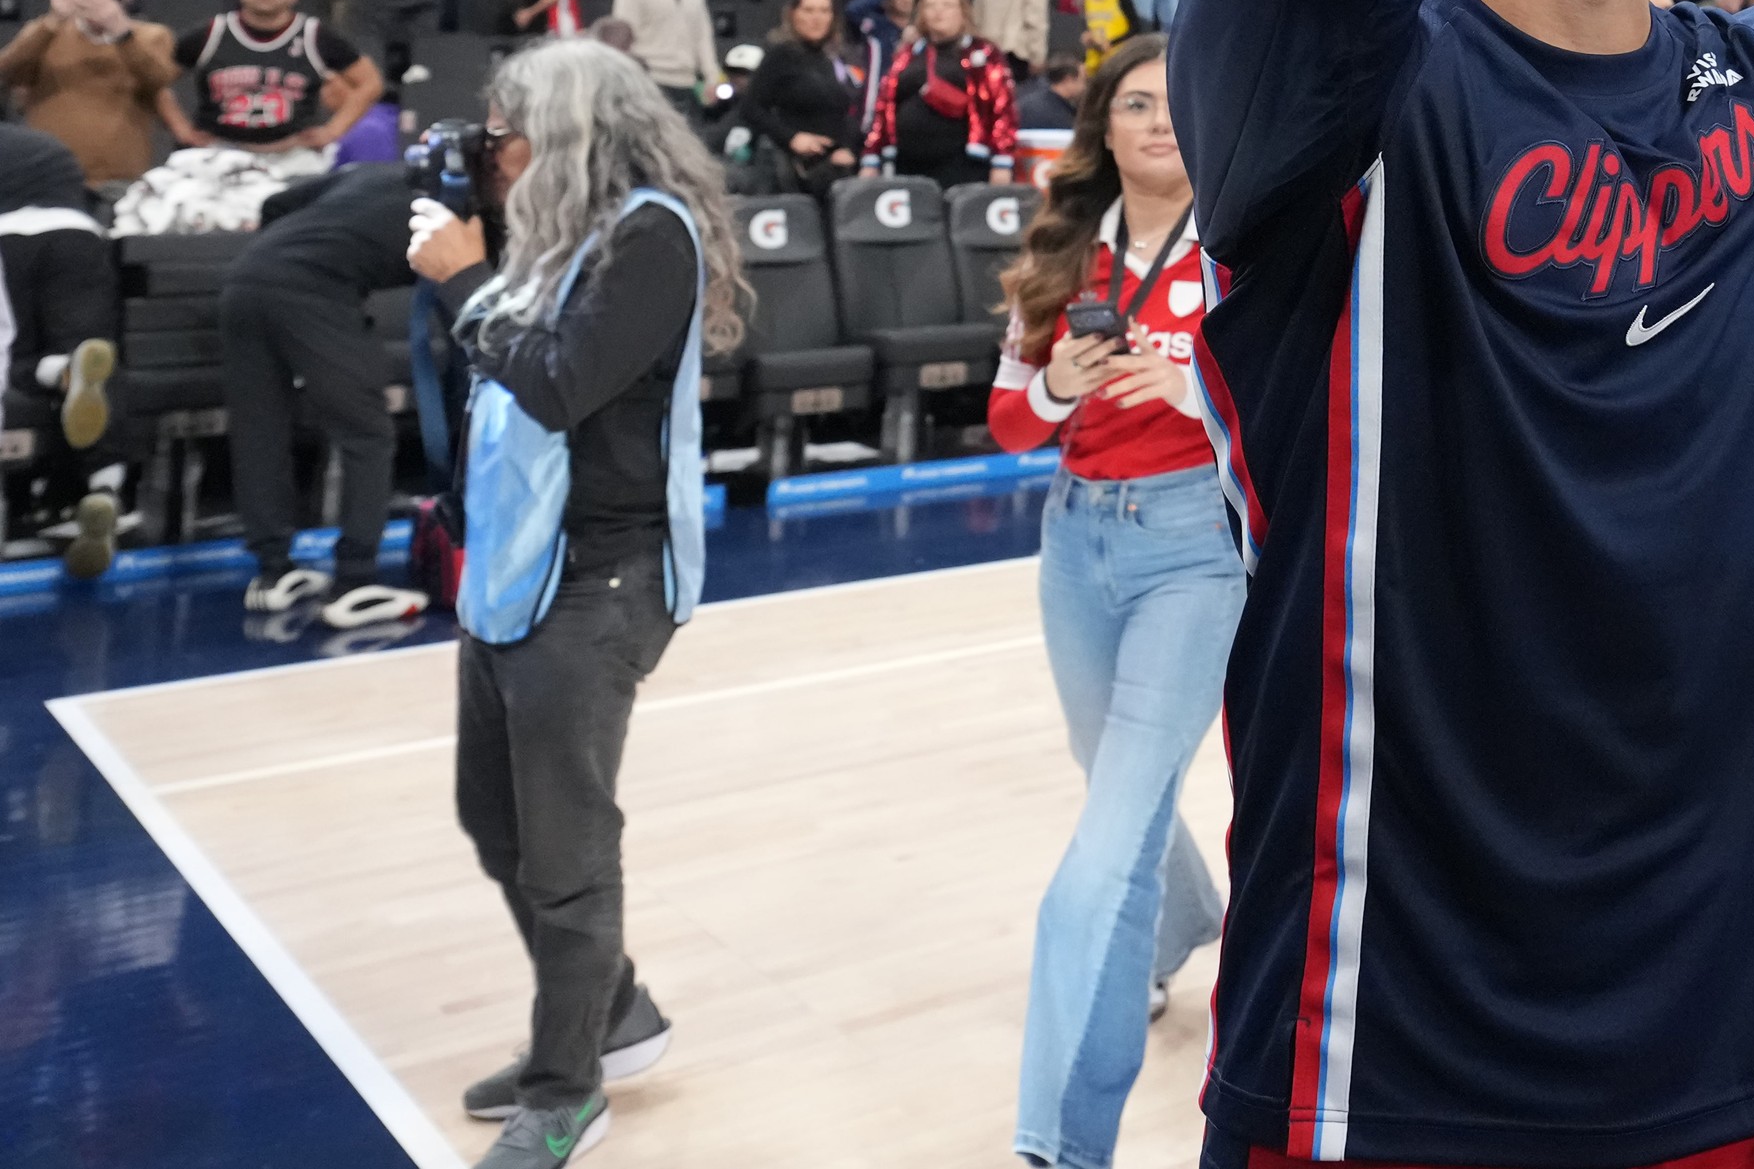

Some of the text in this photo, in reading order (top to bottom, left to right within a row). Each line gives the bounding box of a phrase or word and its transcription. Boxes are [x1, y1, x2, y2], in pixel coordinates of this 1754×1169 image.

[874, 188, 912, 228] G
[985, 197, 1020, 234] G
[748, 208, 788, 249] G
